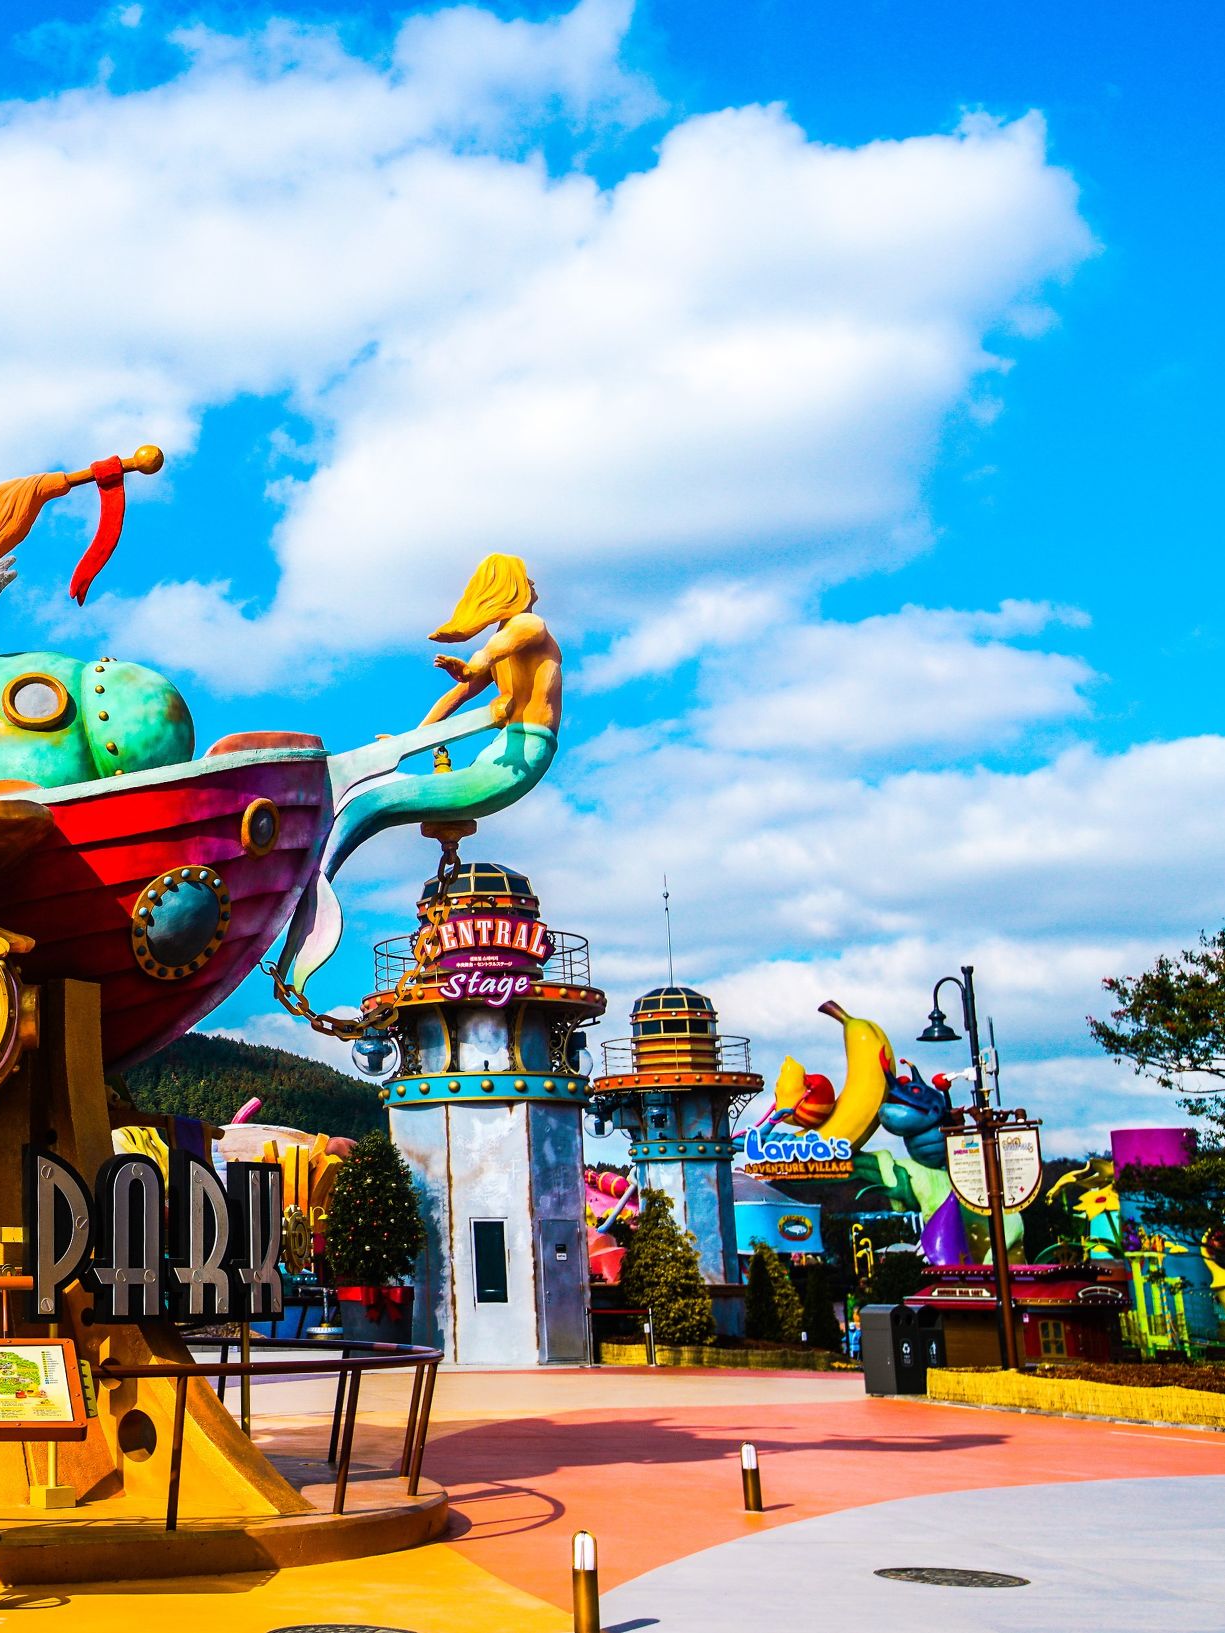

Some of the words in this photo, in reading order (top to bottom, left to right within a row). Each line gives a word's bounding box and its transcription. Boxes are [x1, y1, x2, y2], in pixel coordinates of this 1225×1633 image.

[440, 970, 529, 1006] Stage
[745, 1127, 851, 1163] Larva's
[745, 1162, 806, 1174] ADVENTURE
[807, 1161, 854, 1172] VILLAGE
[38, 1155, 282, 1316] PARK
